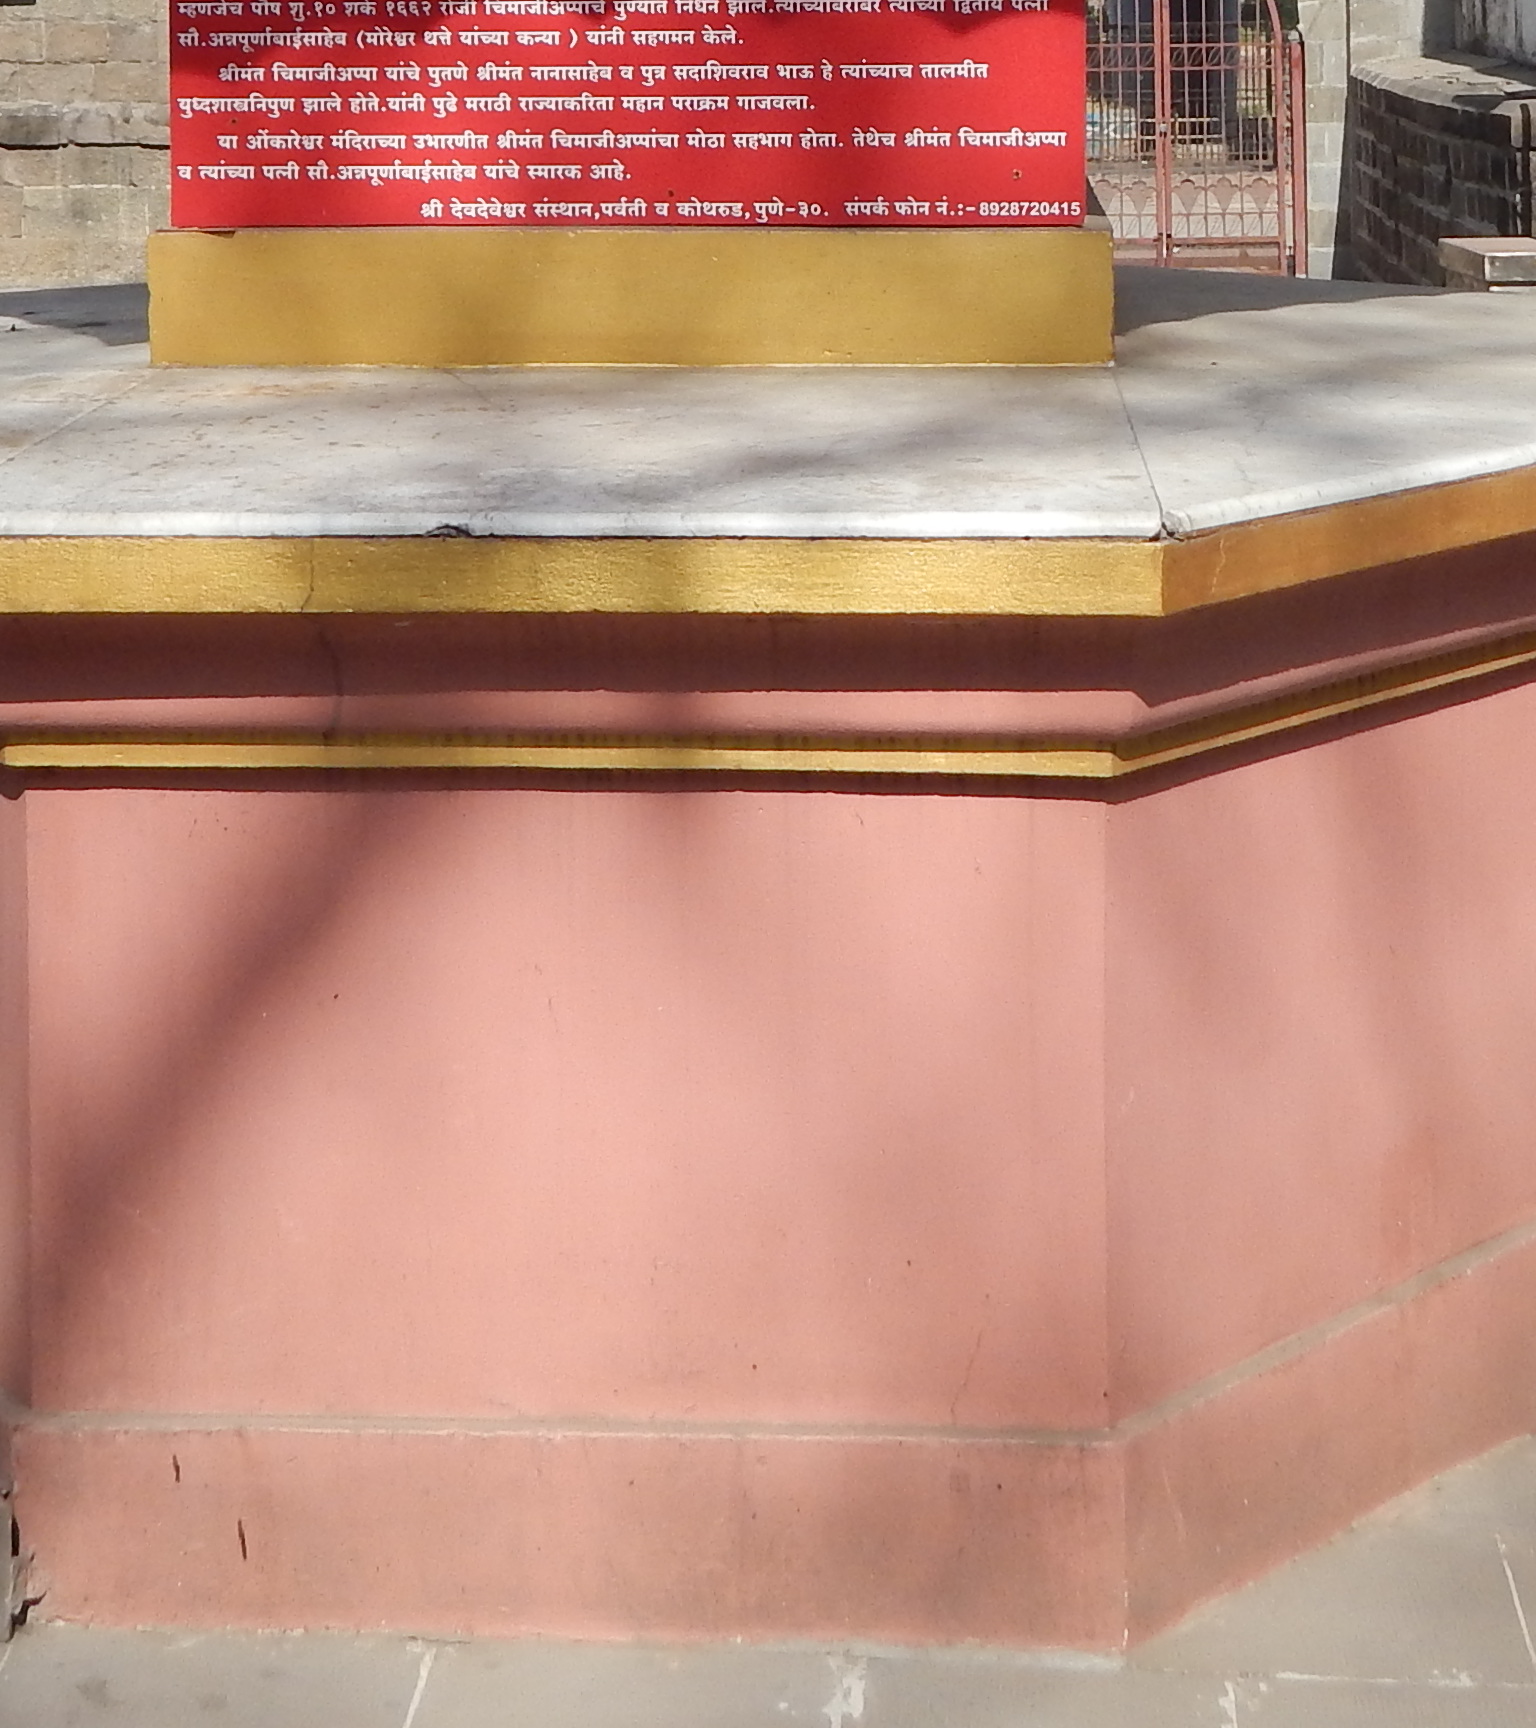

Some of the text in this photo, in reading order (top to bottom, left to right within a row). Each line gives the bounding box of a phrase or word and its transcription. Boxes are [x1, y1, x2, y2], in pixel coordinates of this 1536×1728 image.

[385, 1, 431, 16] १६६२
[612, 0, 668, 20] पुण्यात
[423, 25, 625, 45] थत्ते यांच्या कन्या यांनी
[218, 58, 914, 82] श्रीमंत चिमाजीअप्पा श्रीमंत नानासाहेब सदाशिवराव त्यांच्याच
[300, 92, 730, 114] झाले मराठी राज्याकरिता पराक्रम
[245, 126, 1067, 150] ओंकारेश्वर मंदिराच्या उभारणीत श्रीमंत श्रीमंत चिमाजीअप्पा
[197, 160, 582, 179] त्यांच्या पत्नी स्मारक
[420, 198, 444, 217] श्री
[449, 197, 526, 219] देवदेवेश्वर
[843, 196, 889, 216] संपर्क
[893, 196, 931, 215] फोन
